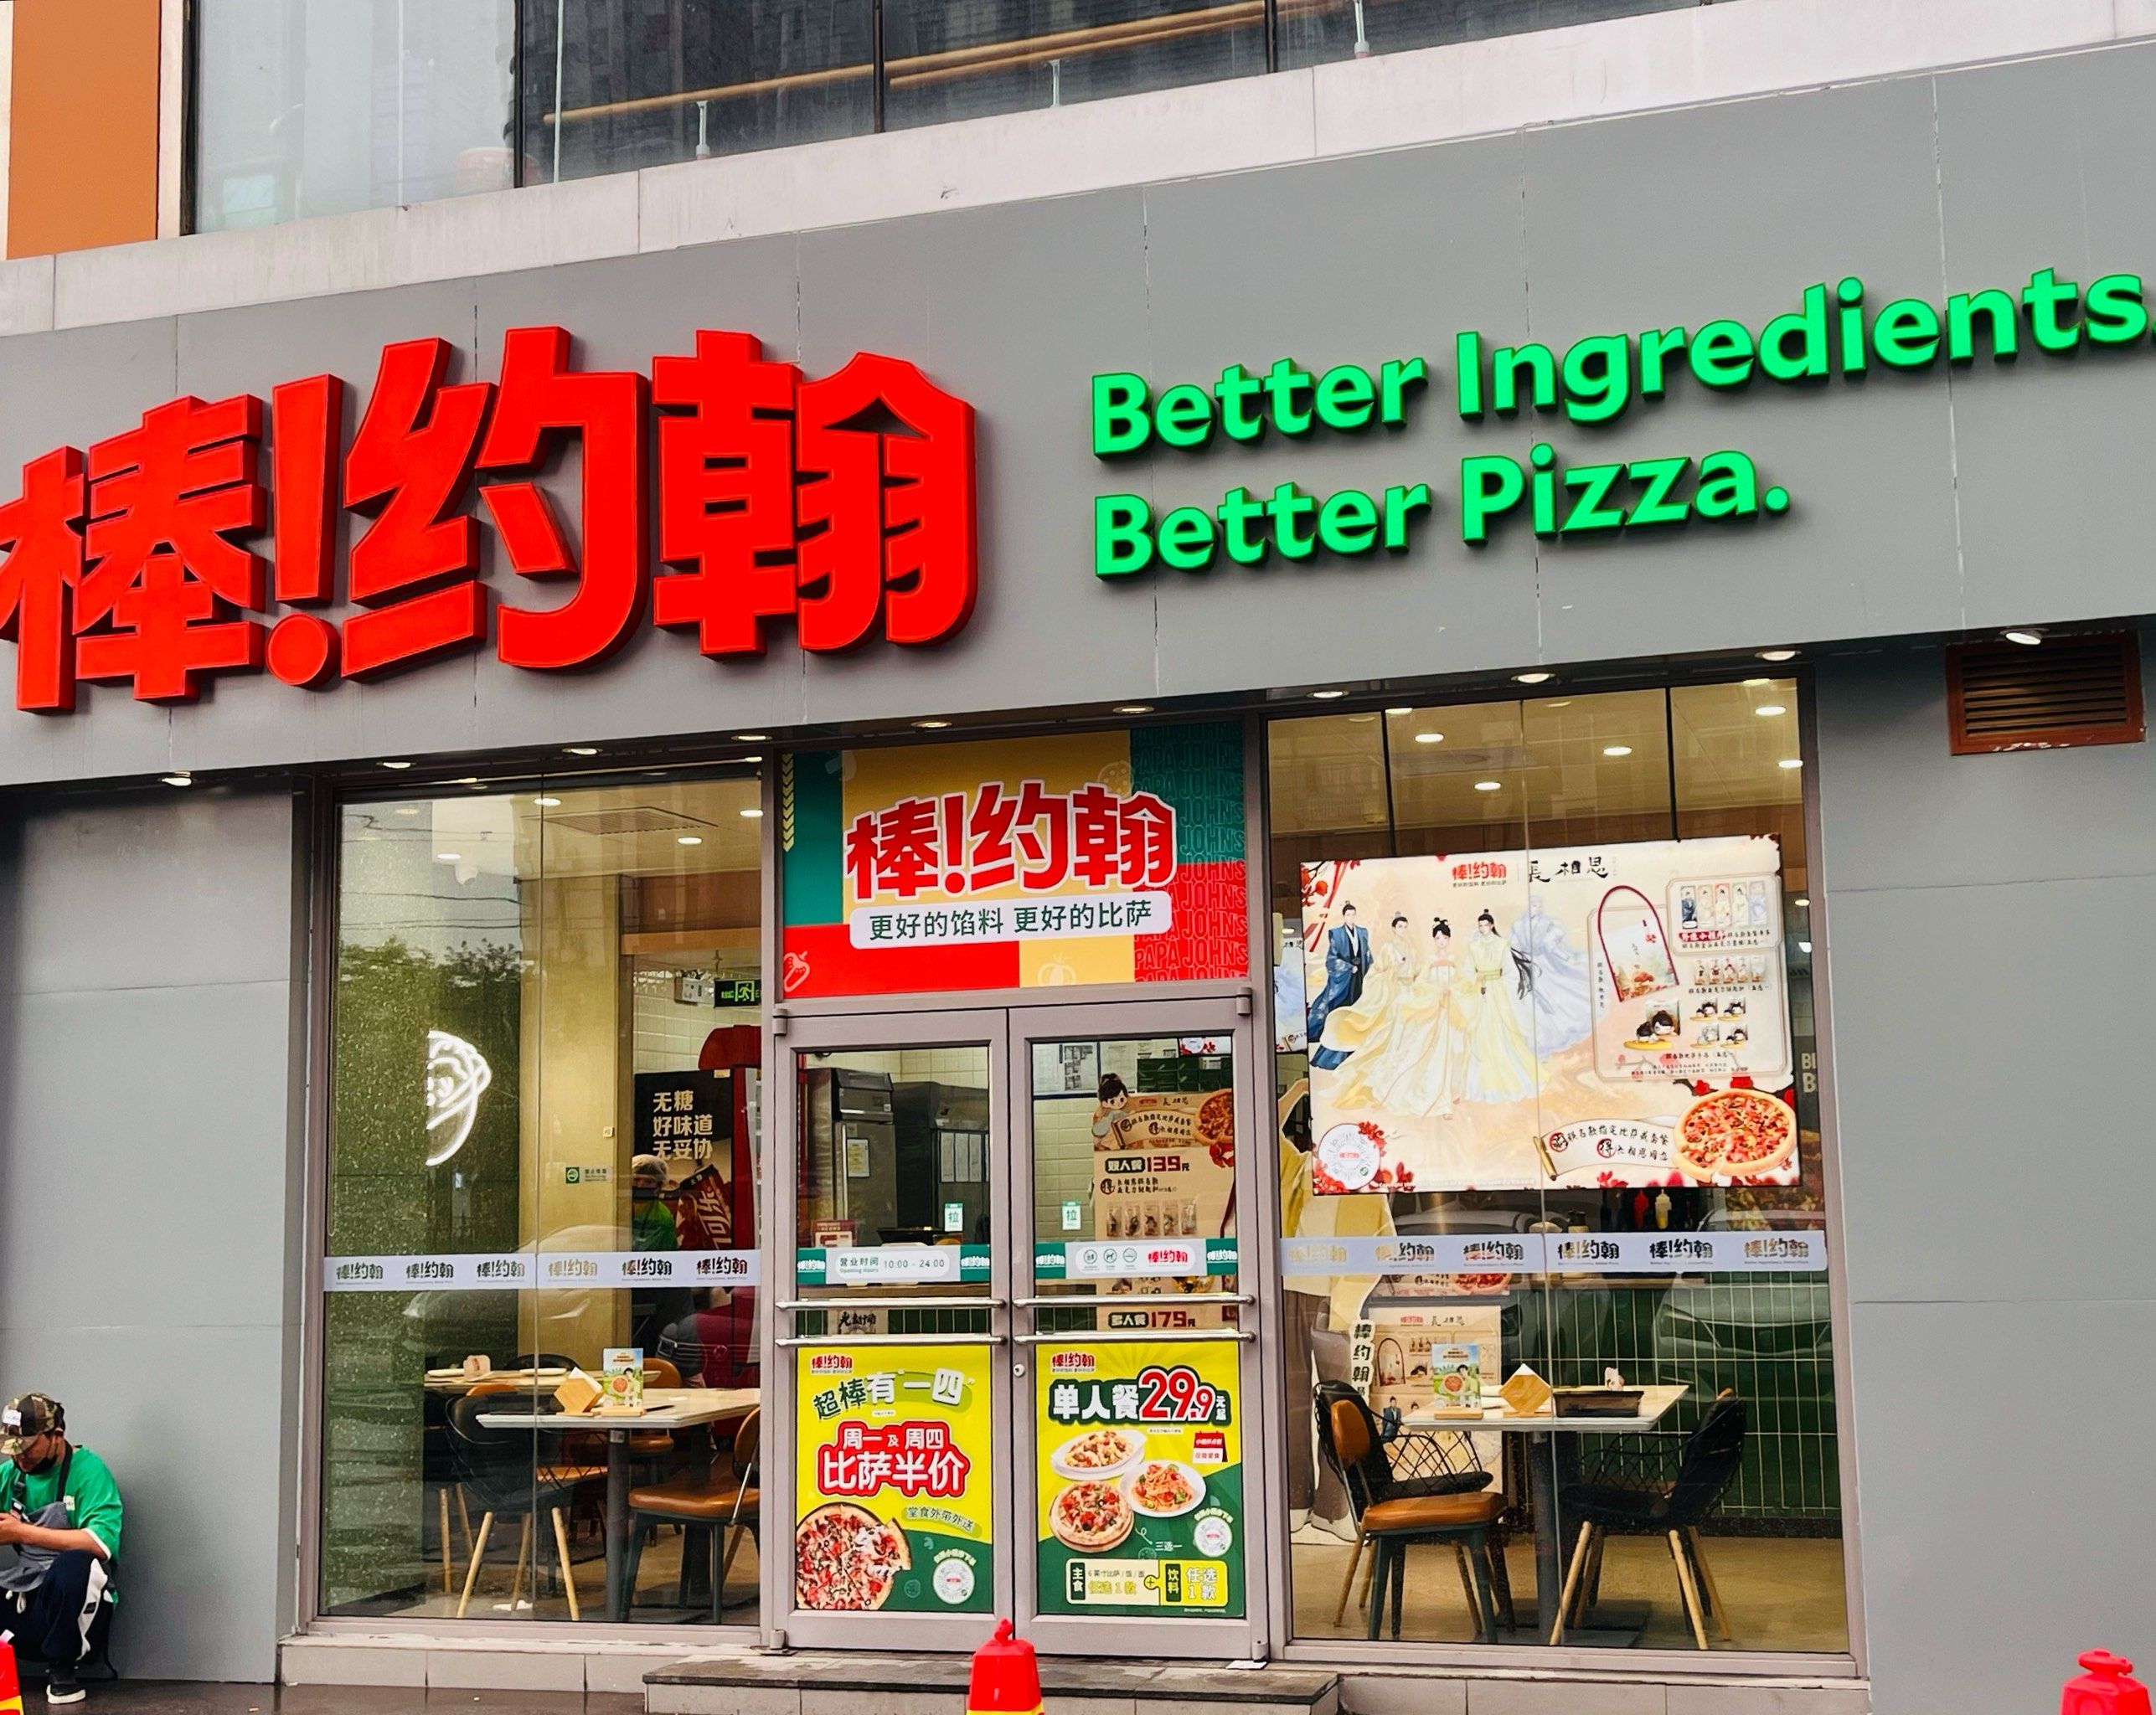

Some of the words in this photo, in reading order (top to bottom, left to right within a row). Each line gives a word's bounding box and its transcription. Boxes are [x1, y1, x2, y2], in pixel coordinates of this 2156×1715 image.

[1091, 355, 1428, 461] Better
[1457, 266, 2156, 426] Ingredients
[1093, 480, 1432, 581] Better
[1462, 442, 1791, 546] Pizza.
[869, 909, 1003, 940] 更好的馅料
[1014, 899, 1153, 933] 更好的比萨
[653, 1090, 694, 1113] 无糖
[653, 1115, 713, 1137] 好味道
[652, 1138, 713, 1161] 无妥协
[840, 1257, 879, 1267] 营业时间
[884, 1259, 909, 1269] 10:00
[1053, 1384, 1139, 1419] 单人餐
[1139, 1369, 1214, 1422] 29.9
[843, 1428, 944, 1450] 周一及周四
[823, 1450, 964, 1491] 比萨半价
[1072, 1568, 1084, 1593] 主食
[1168, 1569, 1179, 1594] 饮料
